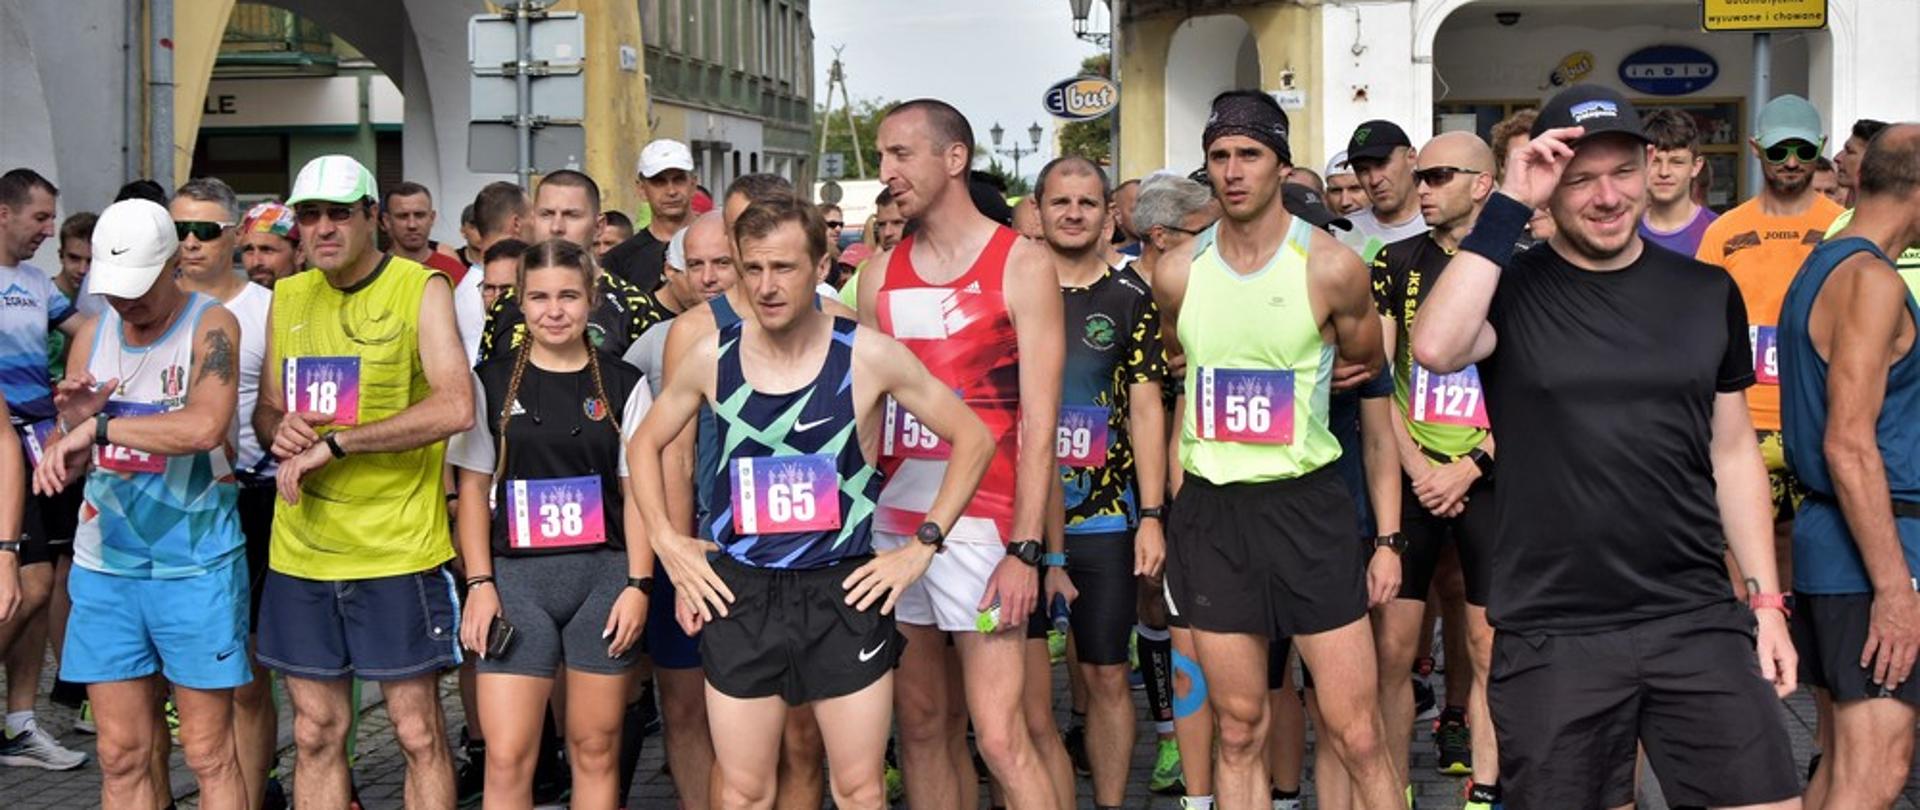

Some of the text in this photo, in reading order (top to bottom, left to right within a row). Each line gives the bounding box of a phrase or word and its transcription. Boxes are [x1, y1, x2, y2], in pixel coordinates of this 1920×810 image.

[1708, 14, 1761, 24] wysuwane
[1774, 11, 1821, 20] chowane
[1407, 270, 1422, 296] JKS
[306, 381, 337, 415] 18
[1226, 395, 1271, 433] 56
[1432, 384, 1479, 418] 127
[1056, 427, 1091, 459] 69
[768, 482, 816, 523] 65
[540, 502, 583, 538] 38
